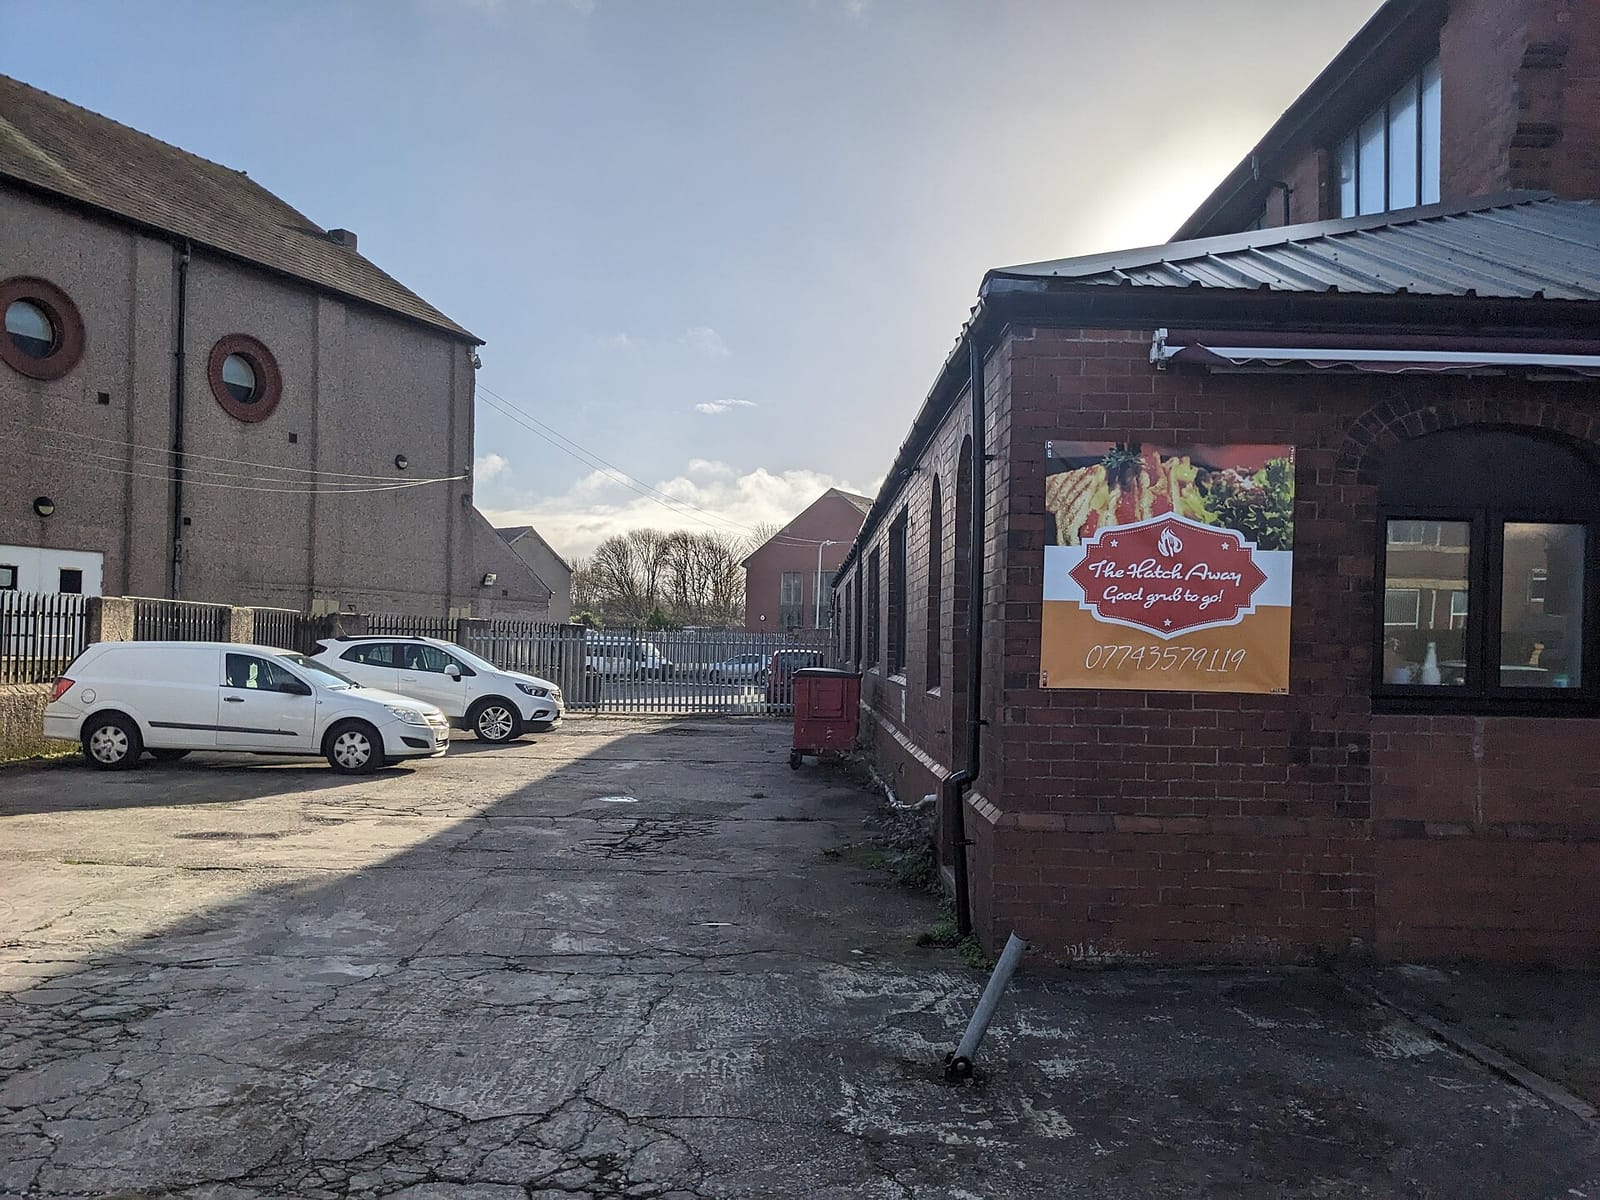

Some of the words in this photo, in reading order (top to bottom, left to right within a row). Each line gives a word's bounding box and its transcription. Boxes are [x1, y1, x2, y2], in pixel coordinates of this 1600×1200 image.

[1088, 560, 1125, 578] The
[1126, 558, 1184, 579] Hatch
[1184, 563, 1242, 587] Away
[1103, 585, 1144, 604] Good
[1143, 587, 1182, 609] grub
[1184, 589, 1200, 602] to
[1199, 589, 1225, 610] go!
[1085, 645, 1247, 673] 07743579119
